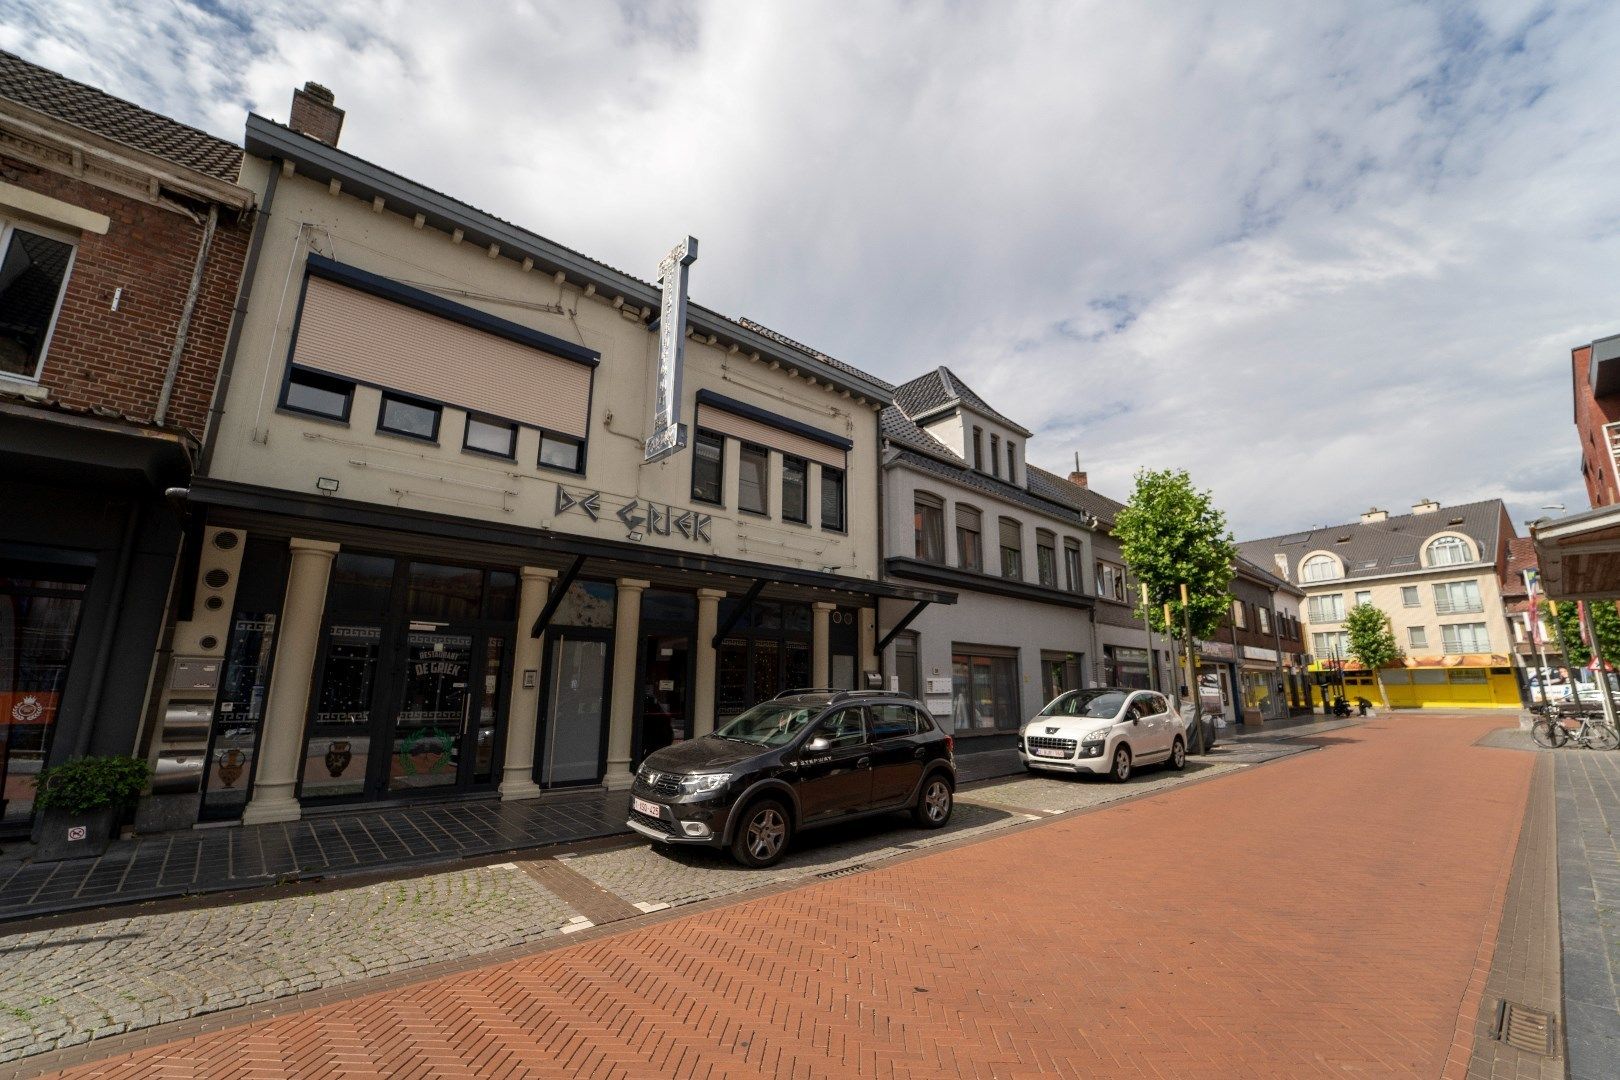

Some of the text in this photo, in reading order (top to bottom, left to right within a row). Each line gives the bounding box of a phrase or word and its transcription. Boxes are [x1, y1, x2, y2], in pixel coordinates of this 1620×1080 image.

[555, 483, 711, 543] DE GRIEK
[419, 651, 459, 661] RESTAURANT
[415, 662, 461, 676] DE GRIEK
[800, 756, 832, 766] STEPWAY
